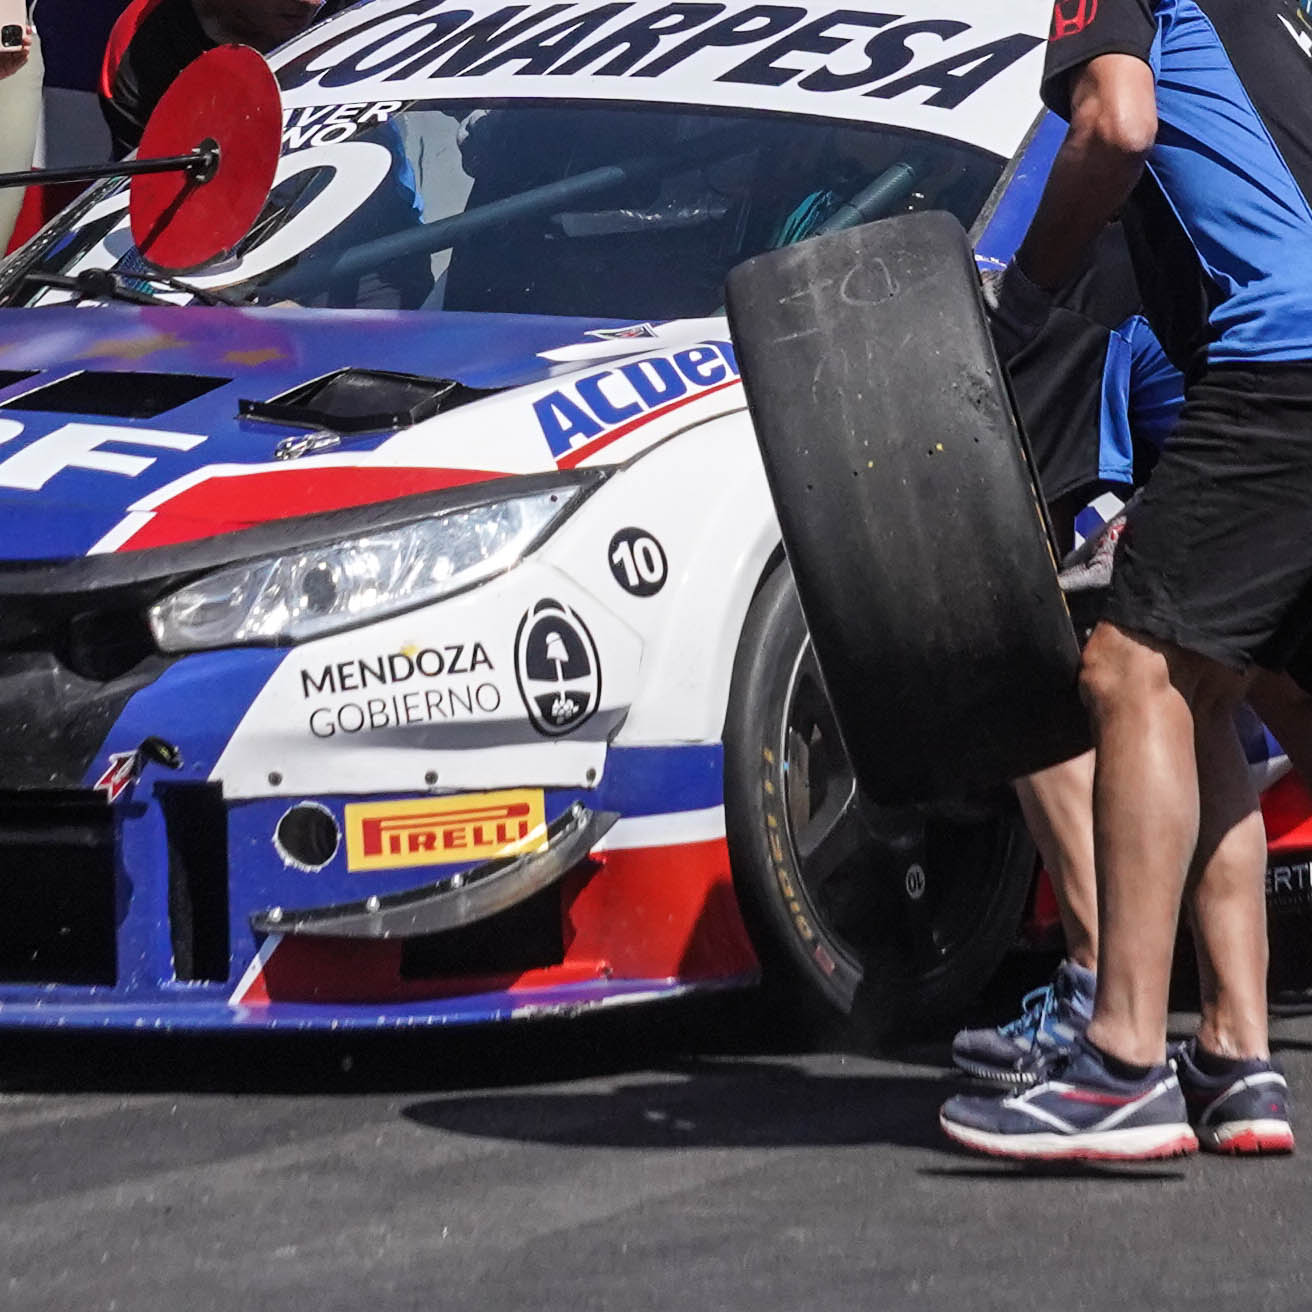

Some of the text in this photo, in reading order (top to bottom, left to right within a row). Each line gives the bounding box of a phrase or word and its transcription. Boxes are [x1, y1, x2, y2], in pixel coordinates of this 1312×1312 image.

[611, 535, 666, 587] 10
[300, 641, 494, 699] MENDOZA
[309, 682, 501, 739] GOBIERNO
[362, 802, 531, 858] PIRELLI
